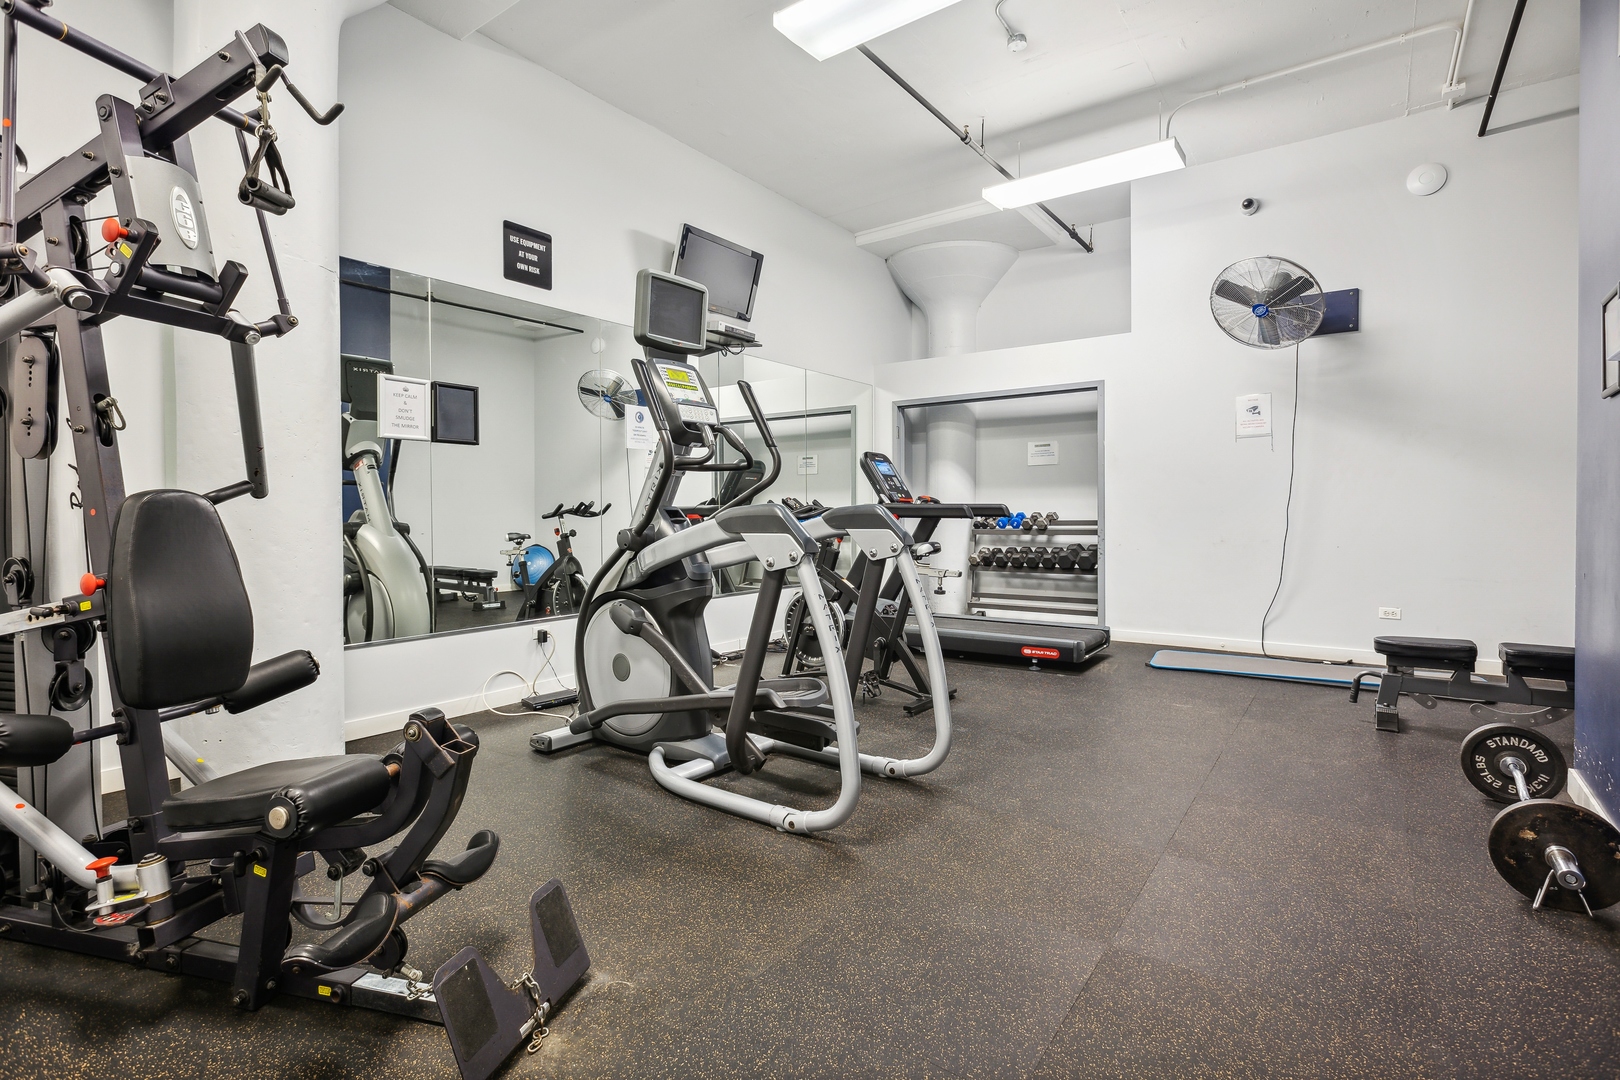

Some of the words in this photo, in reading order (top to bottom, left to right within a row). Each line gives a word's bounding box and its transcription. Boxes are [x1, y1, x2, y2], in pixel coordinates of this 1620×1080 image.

[510, 235, 519, 244] USE
[520, 238, 546, 252] EQUIPMENT
[525, 252, 538, 262] YOUR
[517, 262, 528, 271] OWN
[529, 265, 540, 274] RISK
[1486, 736, 1549, 763] STANDARD
[1507, 773, 1550, 794] 11.3KS
